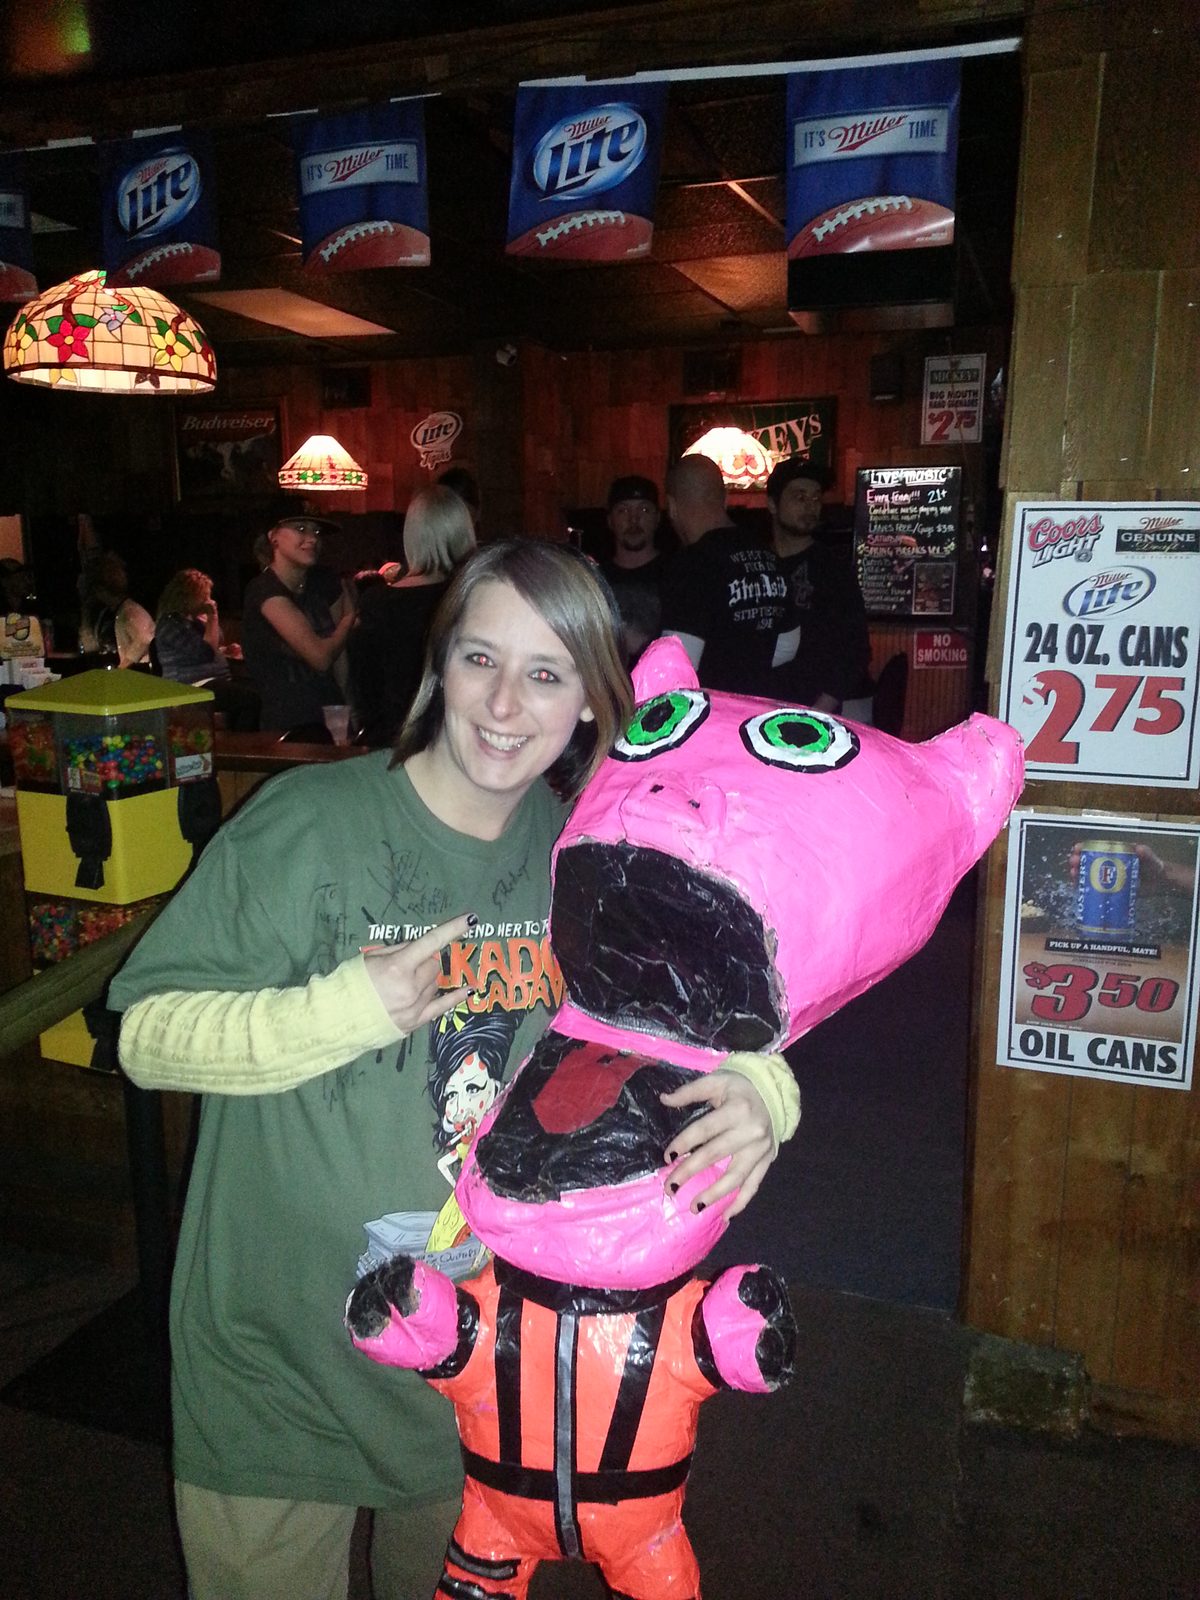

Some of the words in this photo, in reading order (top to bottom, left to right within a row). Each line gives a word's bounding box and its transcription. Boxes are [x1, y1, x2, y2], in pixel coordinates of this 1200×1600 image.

[564, 115, 613, 141] Miller
[804, 129, 826, 149] IT'S
[828, 114, 909, 153] Miller
[909, 118, 939, 139] TIME
[307, 164, 323, 180] IT'S
[324, 149, 385, 184] Miller
[386, 153, 408, 170] TIME
[541, 120, 639, 200] Lite
[127, 161, 191, 240] Lite
[930, 391, 945, 400] BIG
[947, 389, 979, 399] MOUTH
[181, 415, 275, 432] Budweiser
[421, 423, 454, 447] Lite
[927, 488, 948, 503] 21+
[1027, 513, 1104, 551] Coors
[1139, 516, 1184, 533] Miller
[1120, 532, 1196, 543] GENUINE
[1032, 534, 1100, 568] LIGHT
[1089, 572, 1132, 588] Miller
[1077, 580, 1143, 617] Lite
[933, 634, 951, 647] NO
[1023, 622, 1058, 664] 24
[1066, 623, 1110, 666] OZ.
[1119, 625, 1189, 668] CANS
[917, 647, 967, 662] SMOKING
[368, 923, 400, 940] THEY
[497, 922, 522, 937] HER
[524, 920, 540, 936] TO
[1049, 940, 1069, 949] PICK
[1090, 944, 1131, 954] HANDFUL,
[1132, 947, 1158, 956] MATE!
[1019, 1028, 1075, 1062] OIL
[1087, 1037, 1178, 1075] CANS
